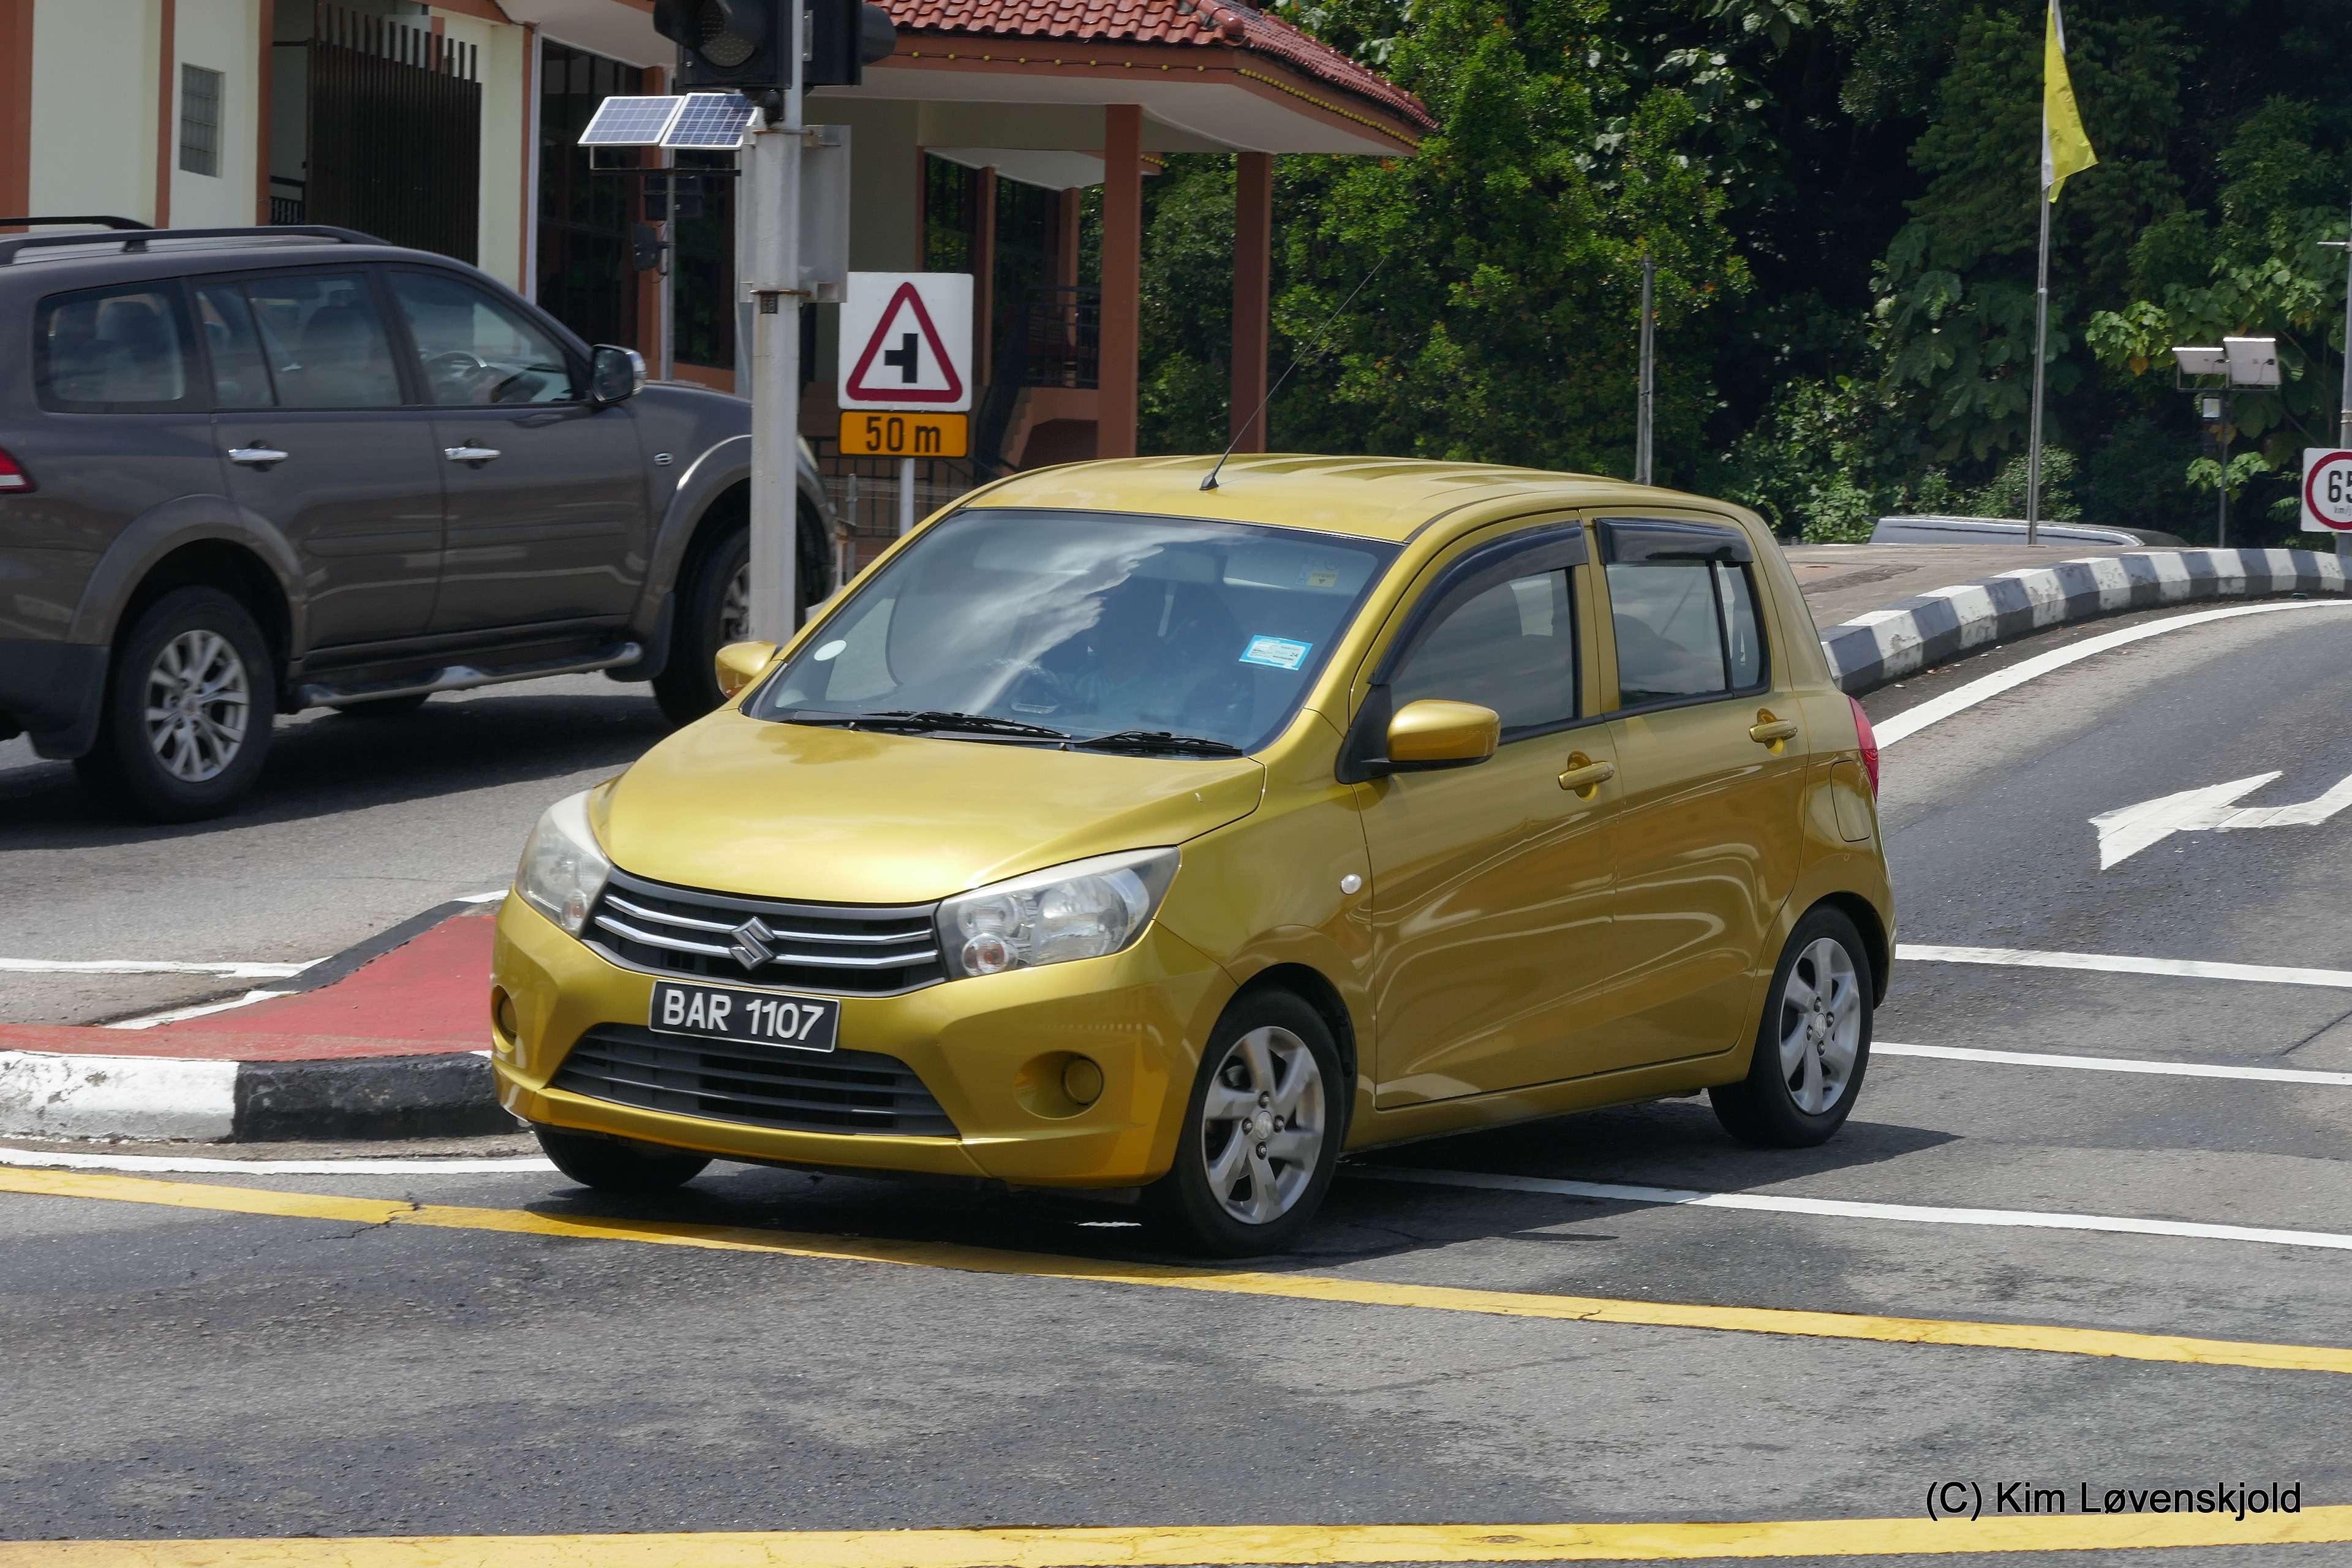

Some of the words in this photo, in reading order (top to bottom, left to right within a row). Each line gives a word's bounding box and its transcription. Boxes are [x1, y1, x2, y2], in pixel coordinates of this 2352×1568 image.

[865, 416, 903, 452] 50
[914, 424, 941, 453] m
[663, 989, 732, 1031] BAR
[745, 998, 825, 1041] 1107
